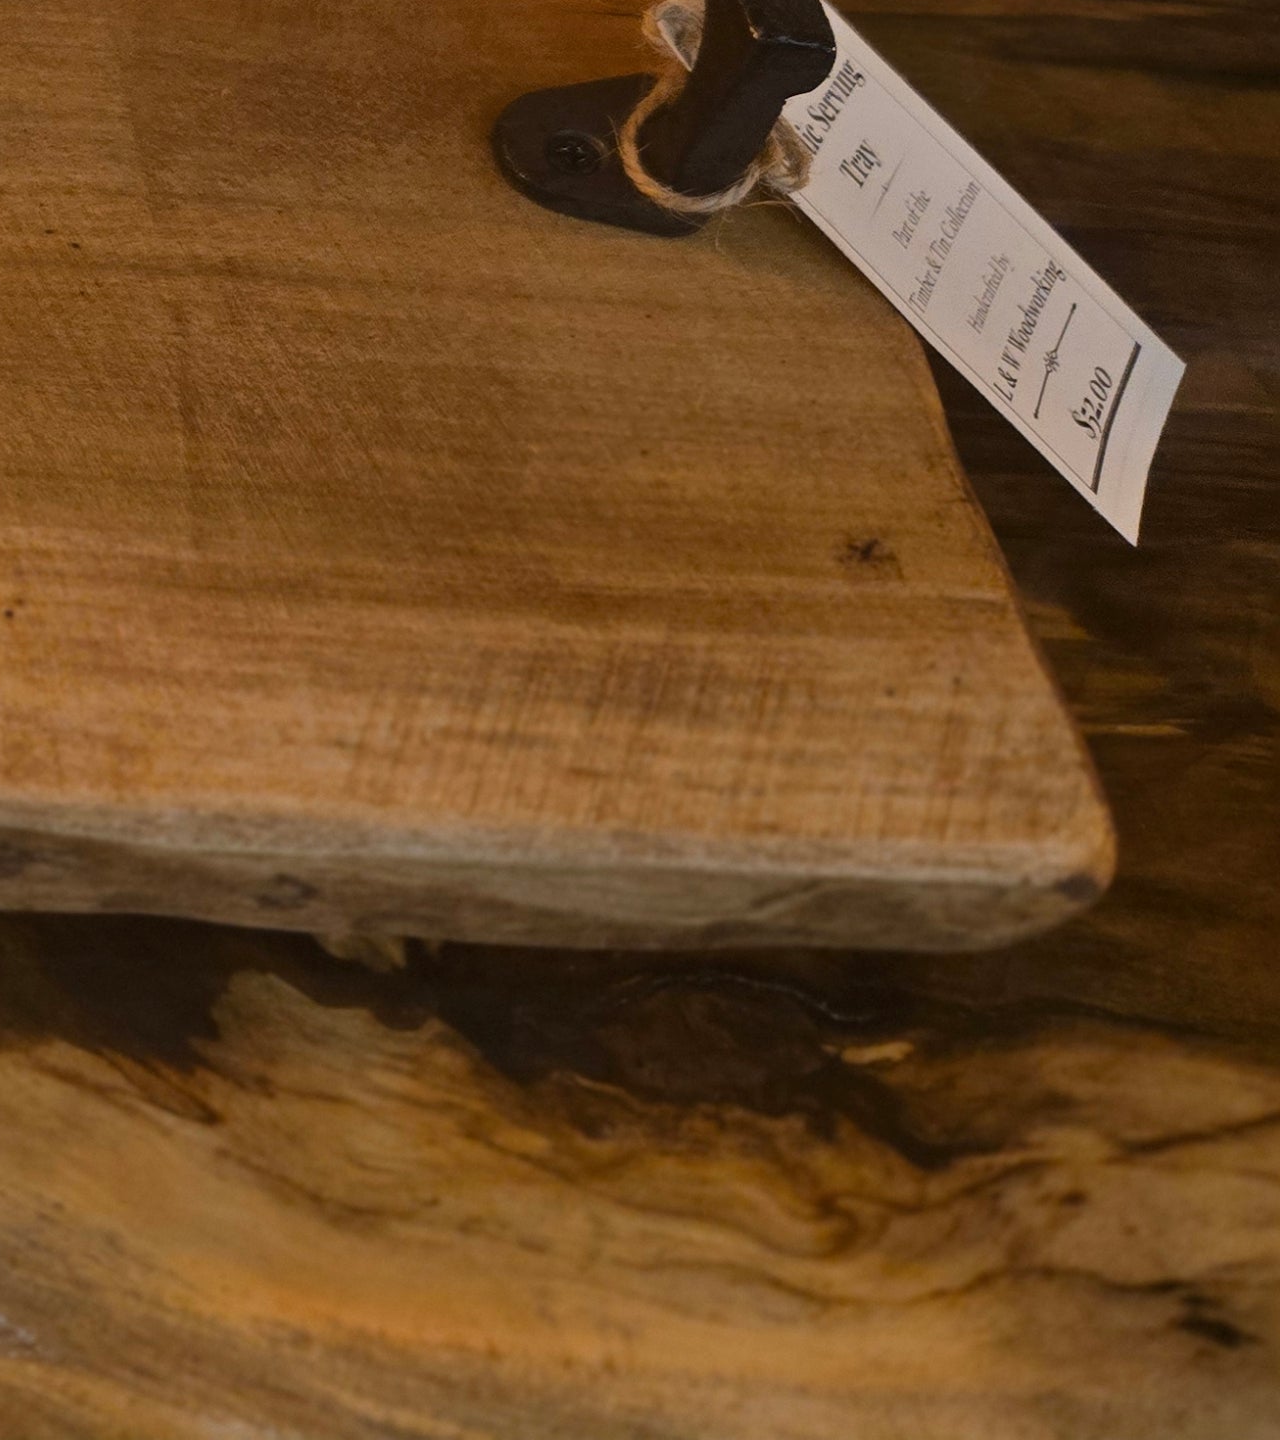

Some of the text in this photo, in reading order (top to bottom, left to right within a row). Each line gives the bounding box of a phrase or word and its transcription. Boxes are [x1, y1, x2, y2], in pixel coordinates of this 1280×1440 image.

[806, 59, 866, 133] Serving
[838, 138, 882, 189] Tray
[892, 190, 932, 250] Part of the
[909, 181, 981, 314] Timber & Tin Collection
[966, 252, 1015, 335] Handcrafted by
[993, 260, 1067, 402] L & W Woodworking
[1071, 366, 1113, 440] $52.00
